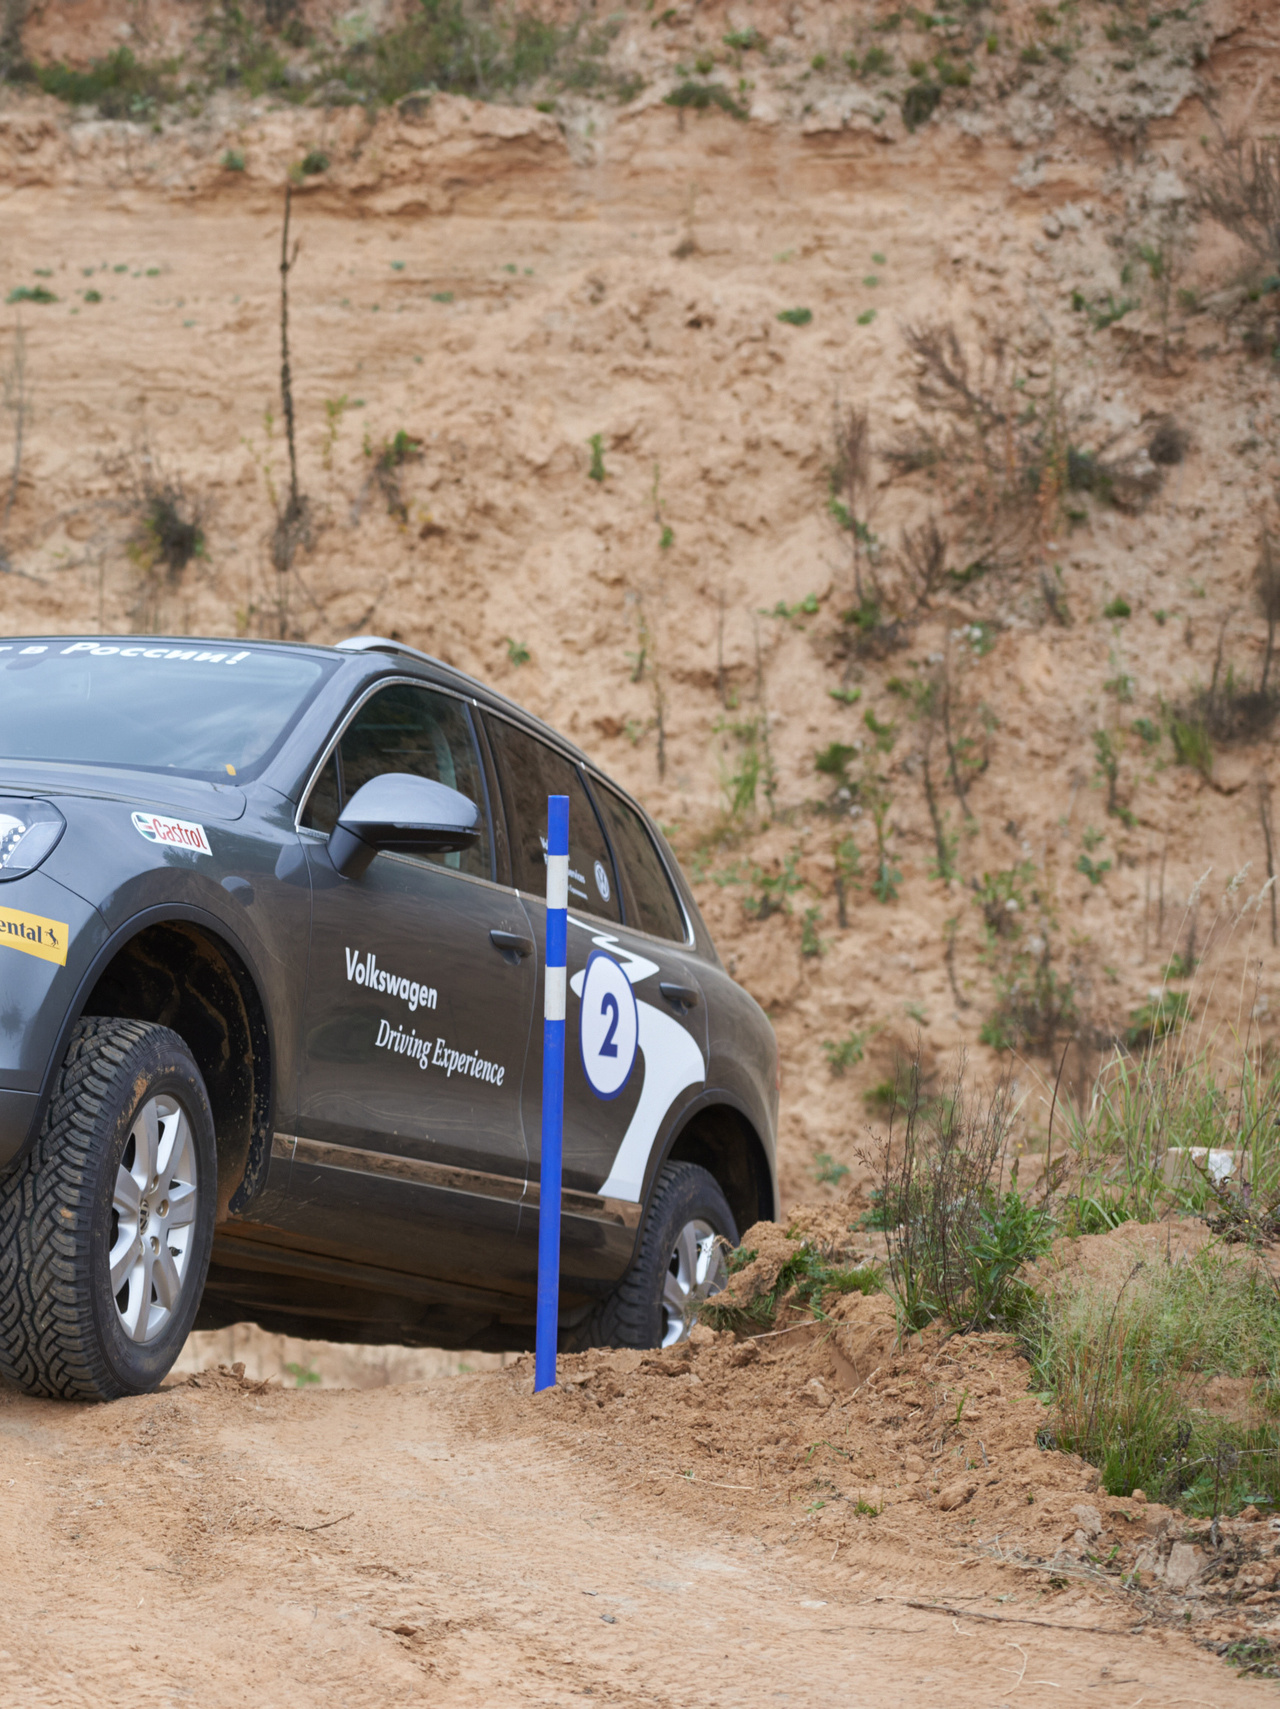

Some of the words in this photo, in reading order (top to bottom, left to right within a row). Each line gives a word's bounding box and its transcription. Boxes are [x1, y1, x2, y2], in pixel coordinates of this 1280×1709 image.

[60, 642, 251, 665] России!
[152, 818, 208, 850] Castrol
[345, 947, 438, 1012] Volkswagen
[375, 1019, 432, 1070] Driving
[431, 1037, 505, 1087] Experience
[598, 992, 619, 1058] 2
